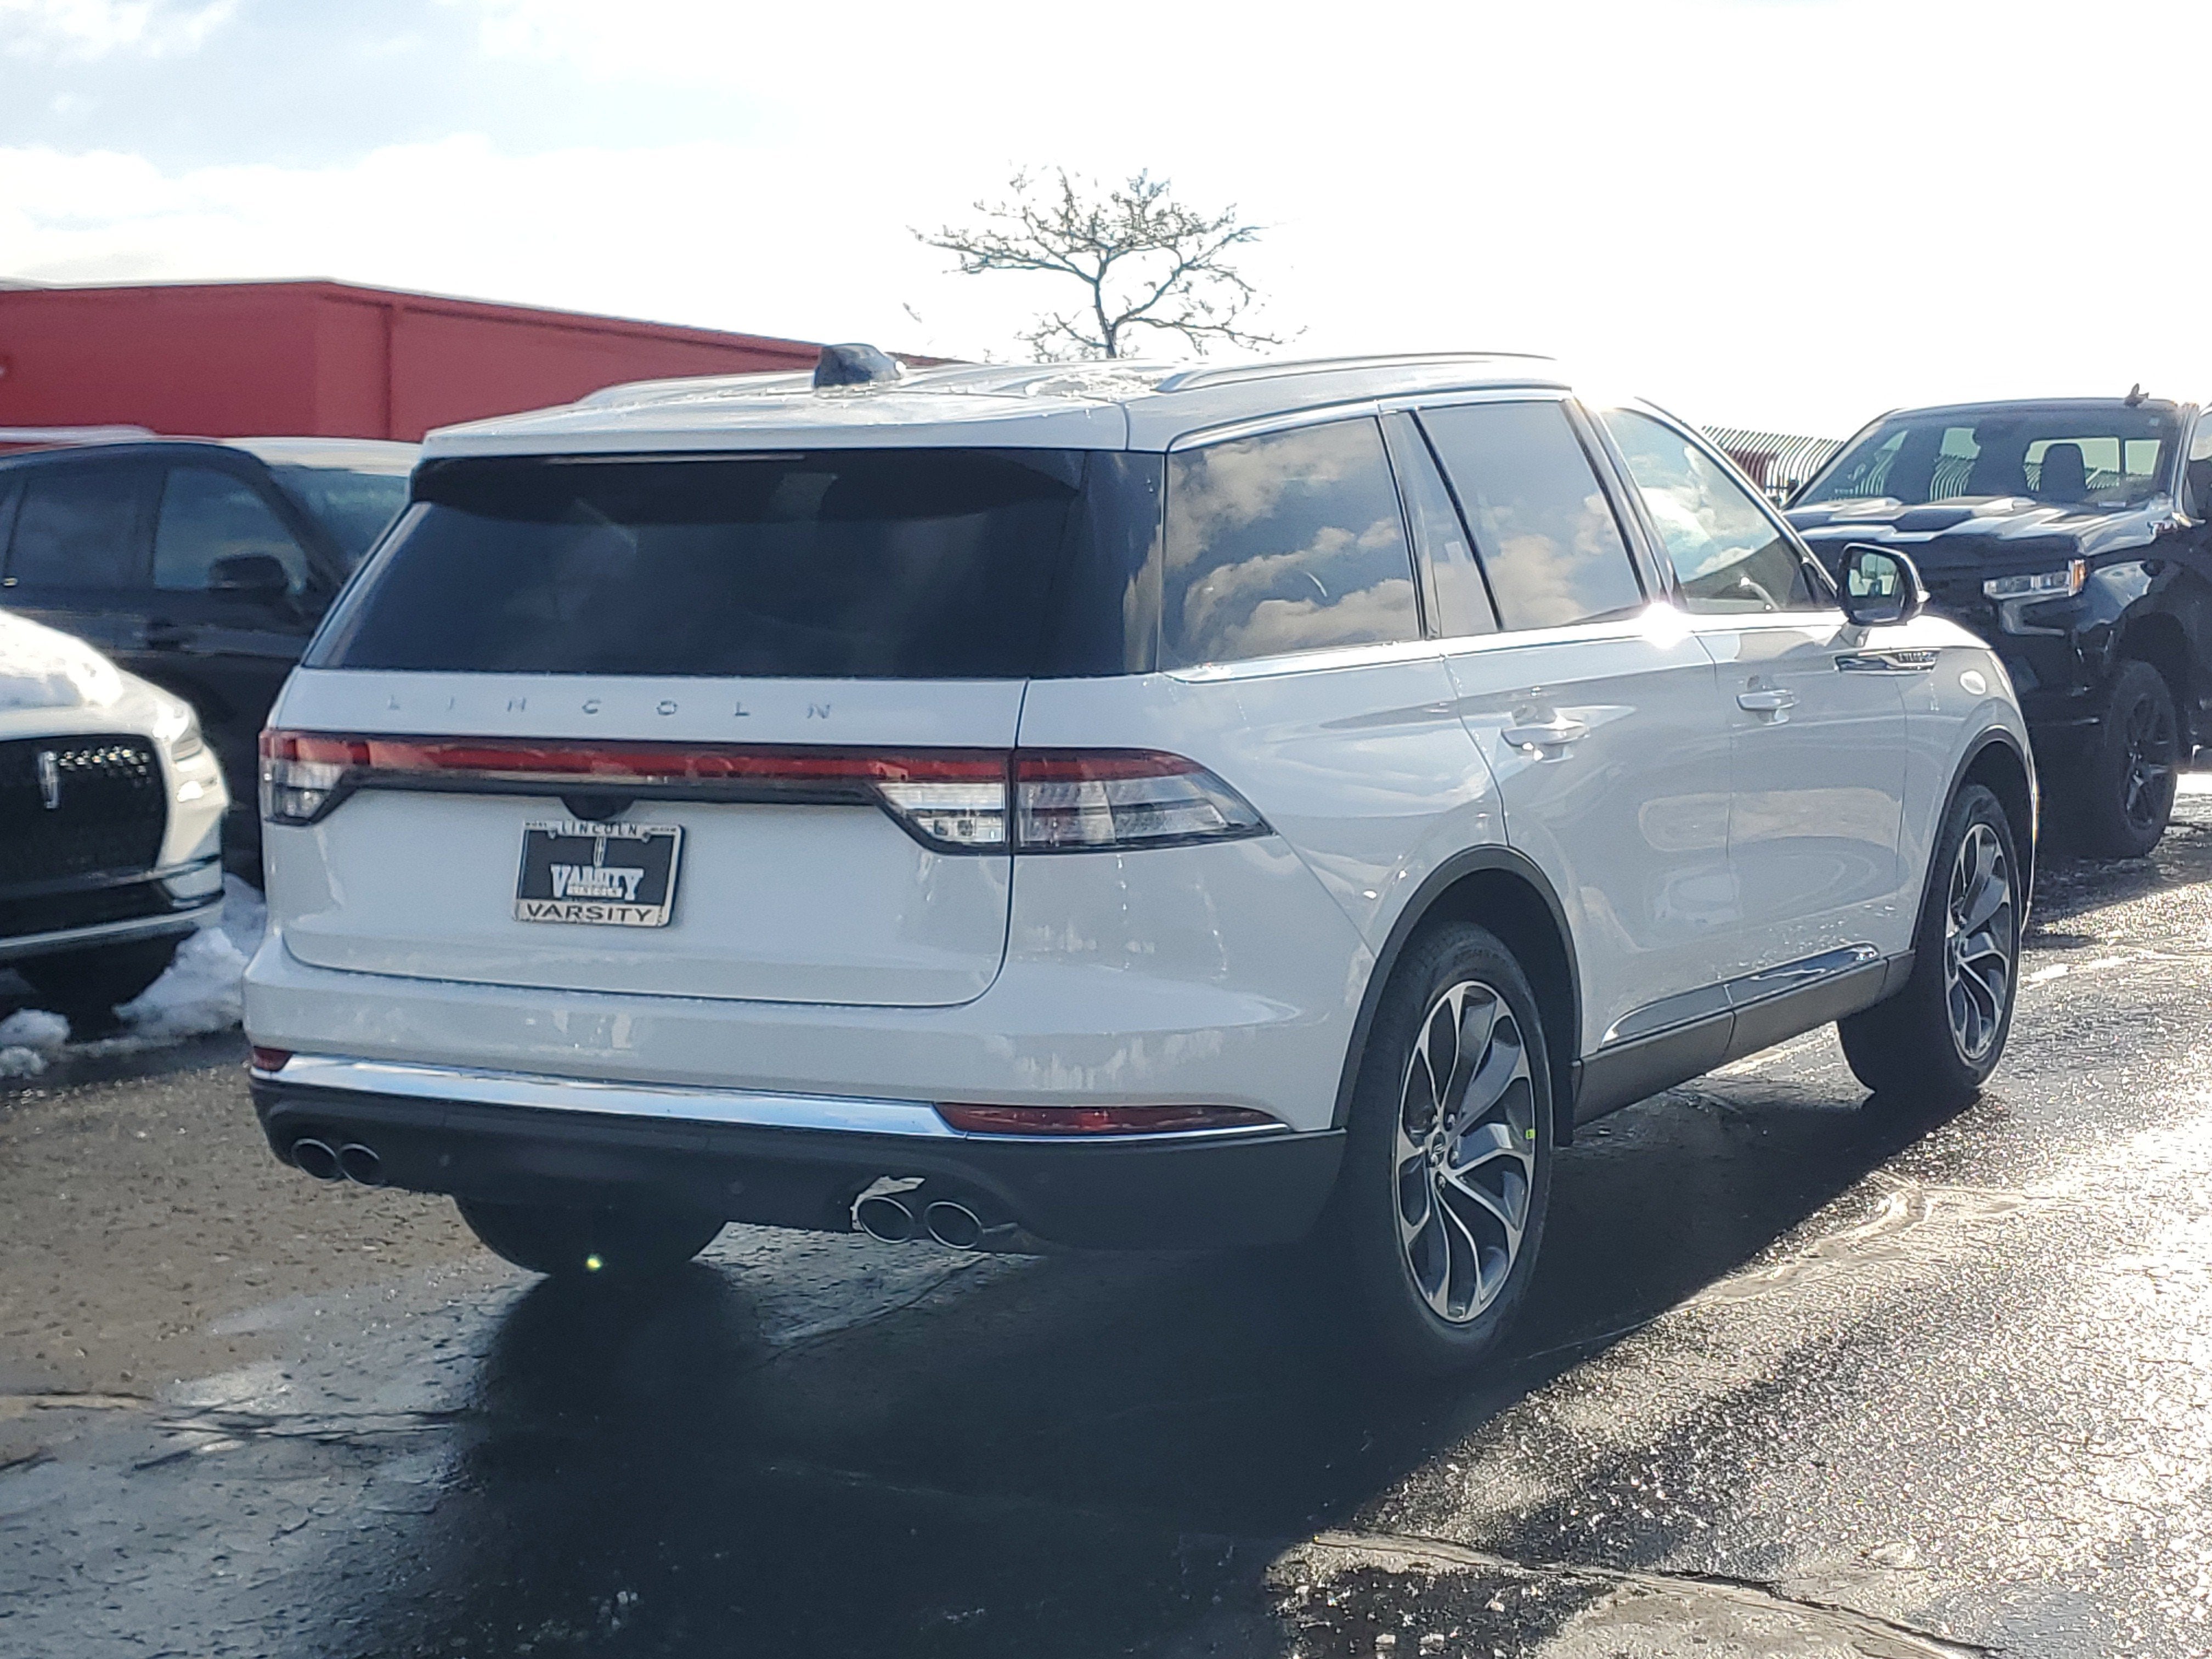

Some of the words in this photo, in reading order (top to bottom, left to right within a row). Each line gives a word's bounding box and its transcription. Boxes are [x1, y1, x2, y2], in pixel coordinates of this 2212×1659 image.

[387, 694, 832, 720] LINCOLN
[561, 820, 637, 836] LINCOLN
[526, 904, 652, 922] VARSITY
